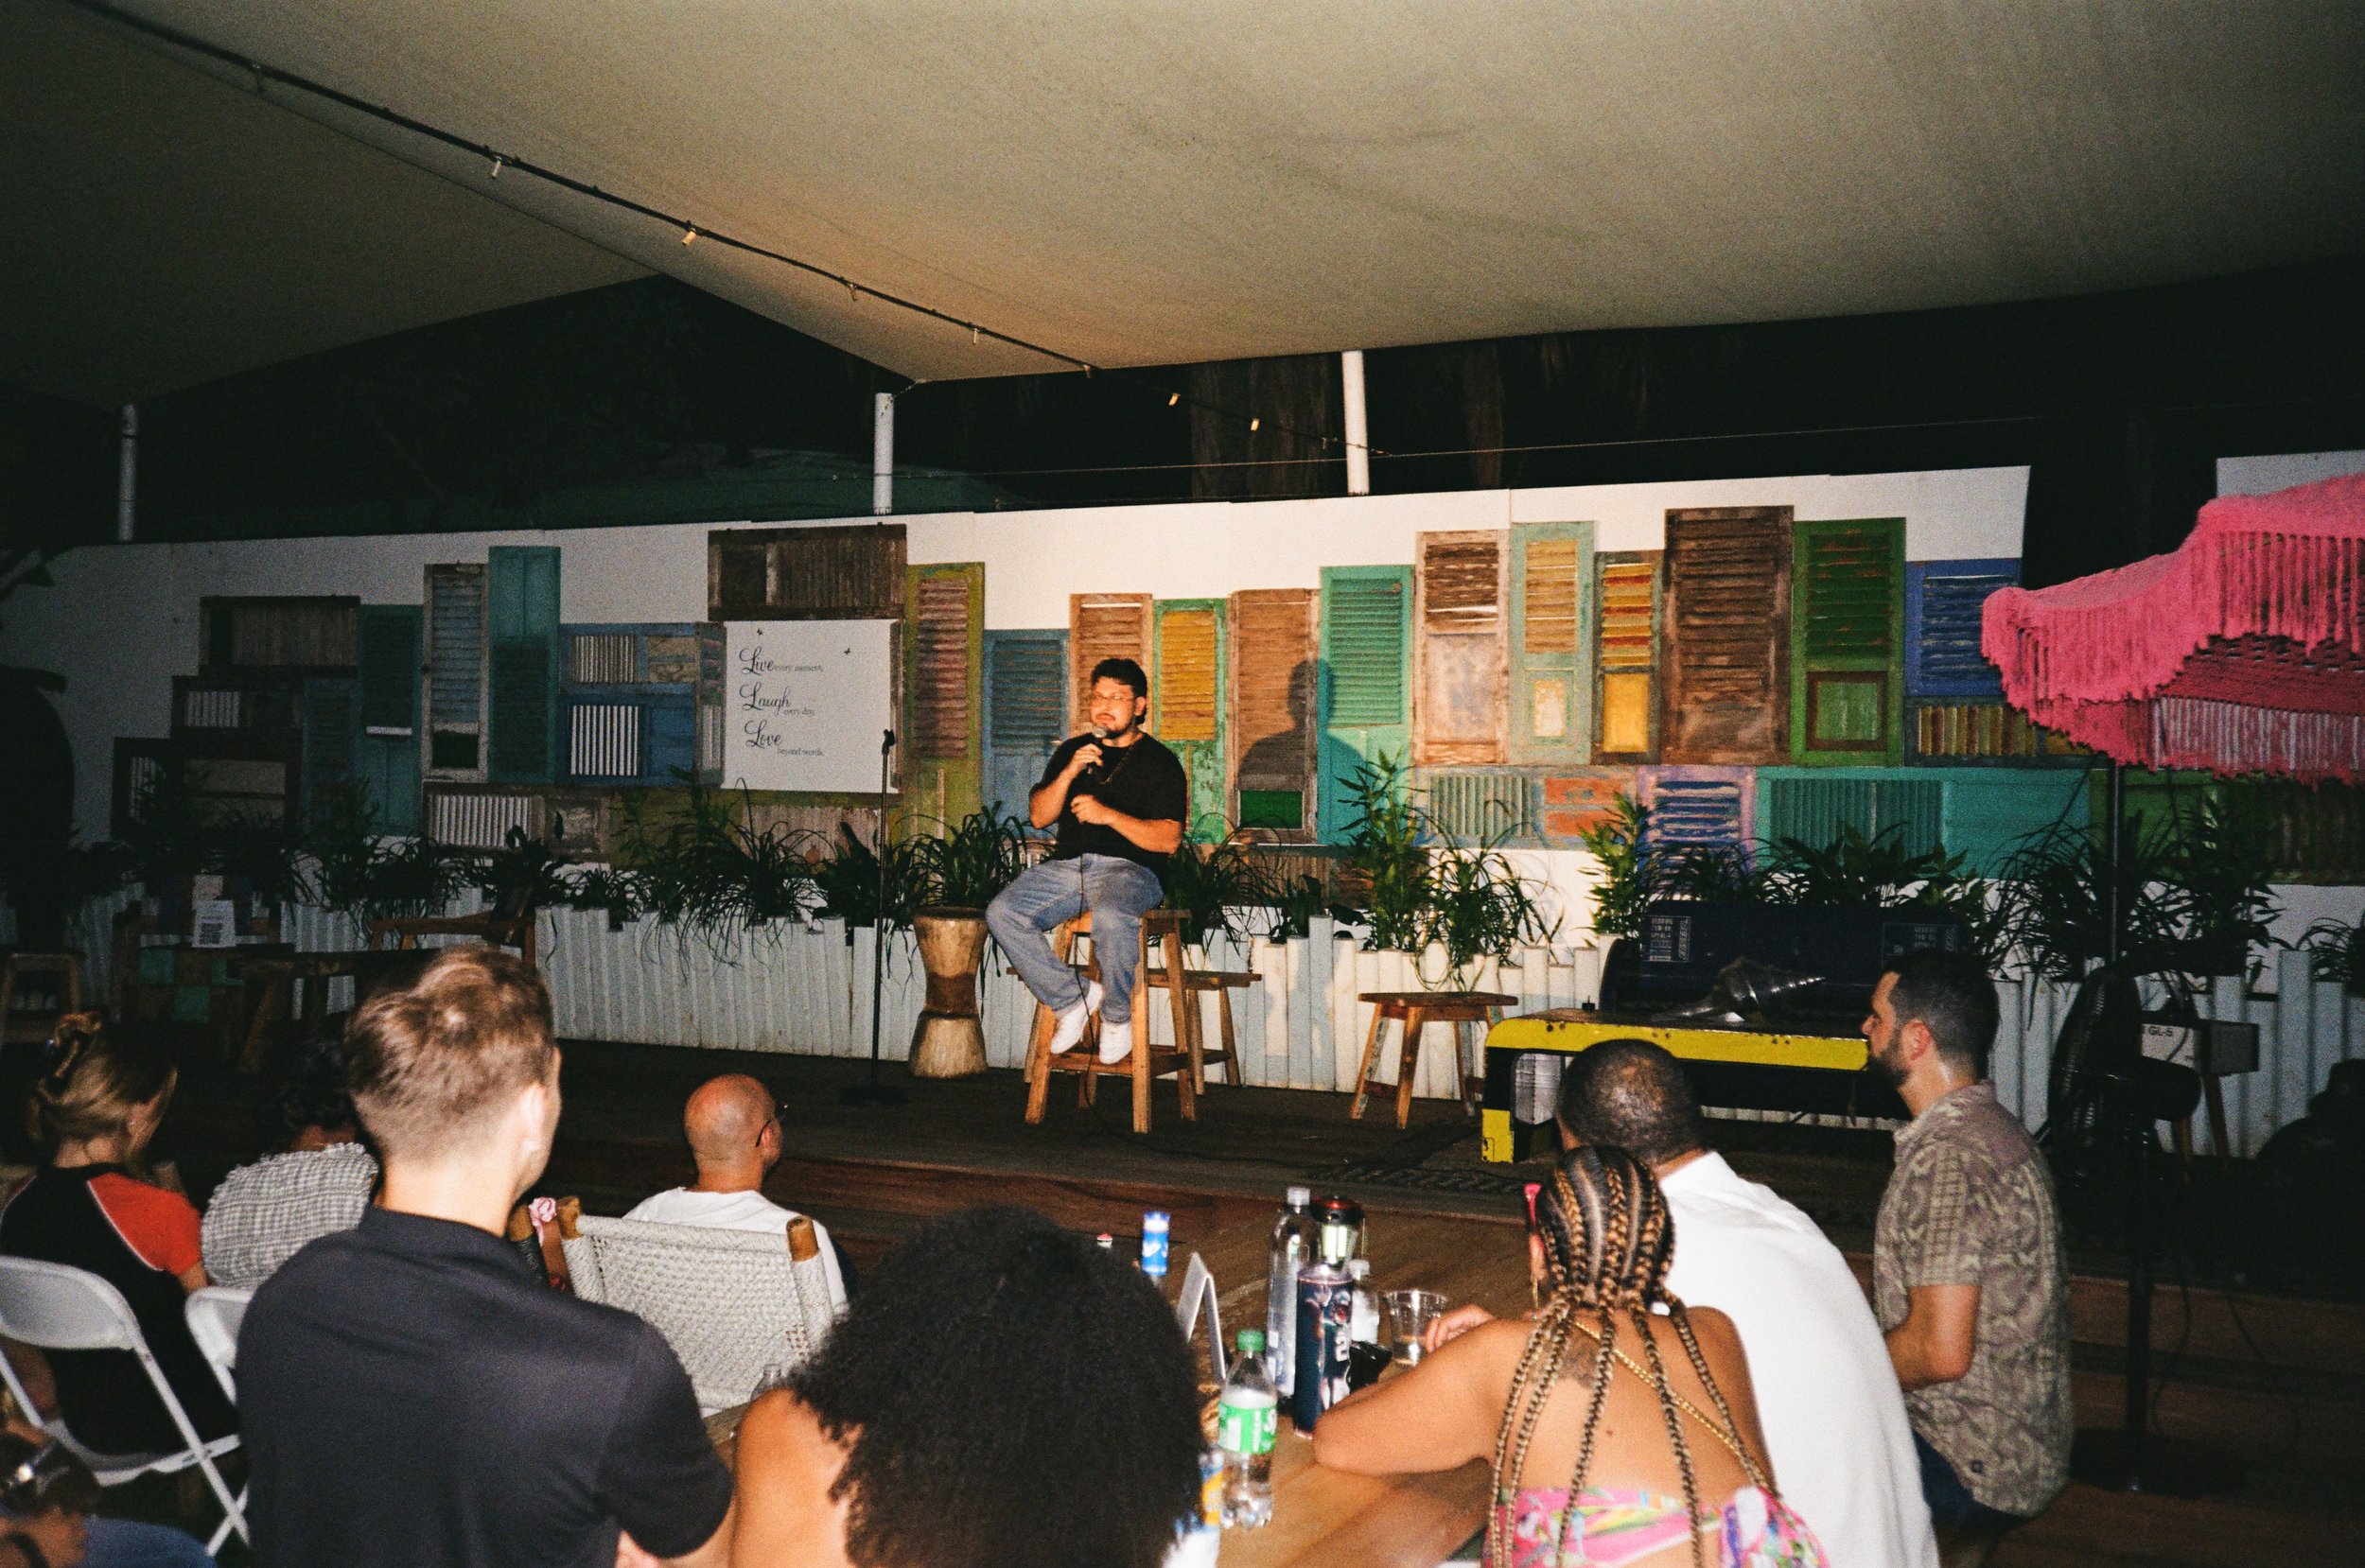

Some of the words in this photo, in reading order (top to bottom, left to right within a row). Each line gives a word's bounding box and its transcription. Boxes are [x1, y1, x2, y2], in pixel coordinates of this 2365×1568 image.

[739, 646, 775, 675] Live
[739, 682, 790, 716] Laugh
[745, 720, 781, 748] Love
